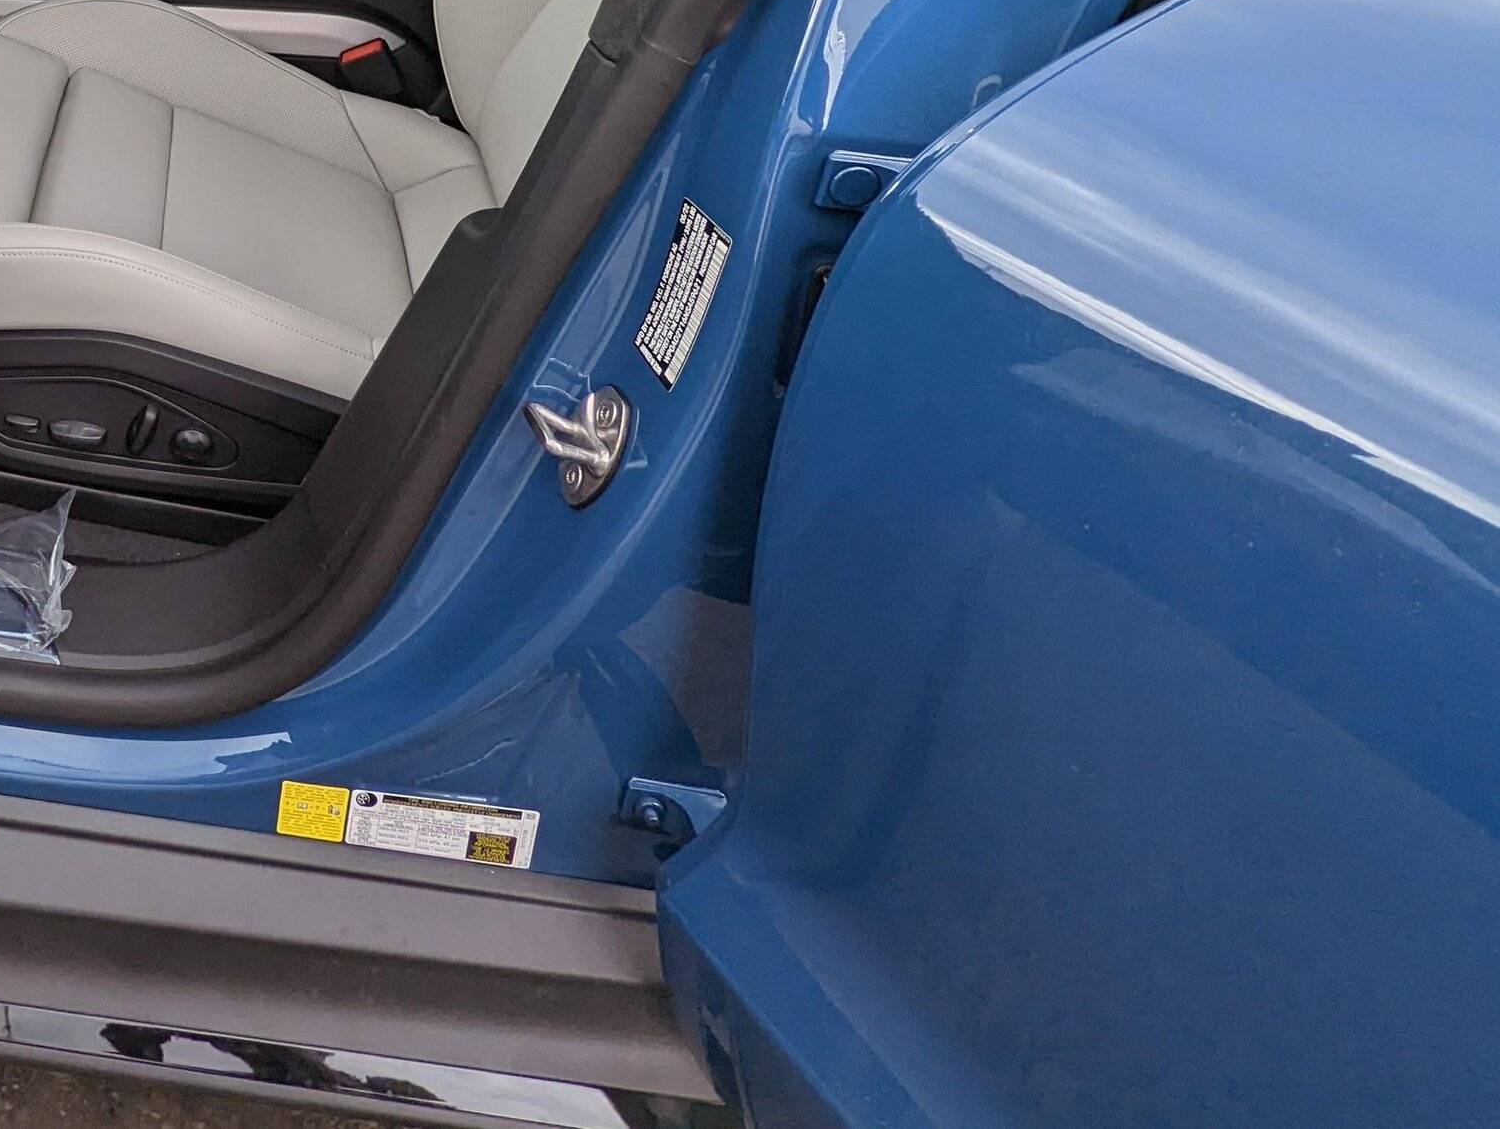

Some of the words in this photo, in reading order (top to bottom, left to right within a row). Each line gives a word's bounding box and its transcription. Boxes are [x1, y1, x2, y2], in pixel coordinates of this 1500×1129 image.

[708, 230, 717, 246] CAR
[634, 329, 644, 348] MFD
[661, 250, 674, 283] PORSCHE
